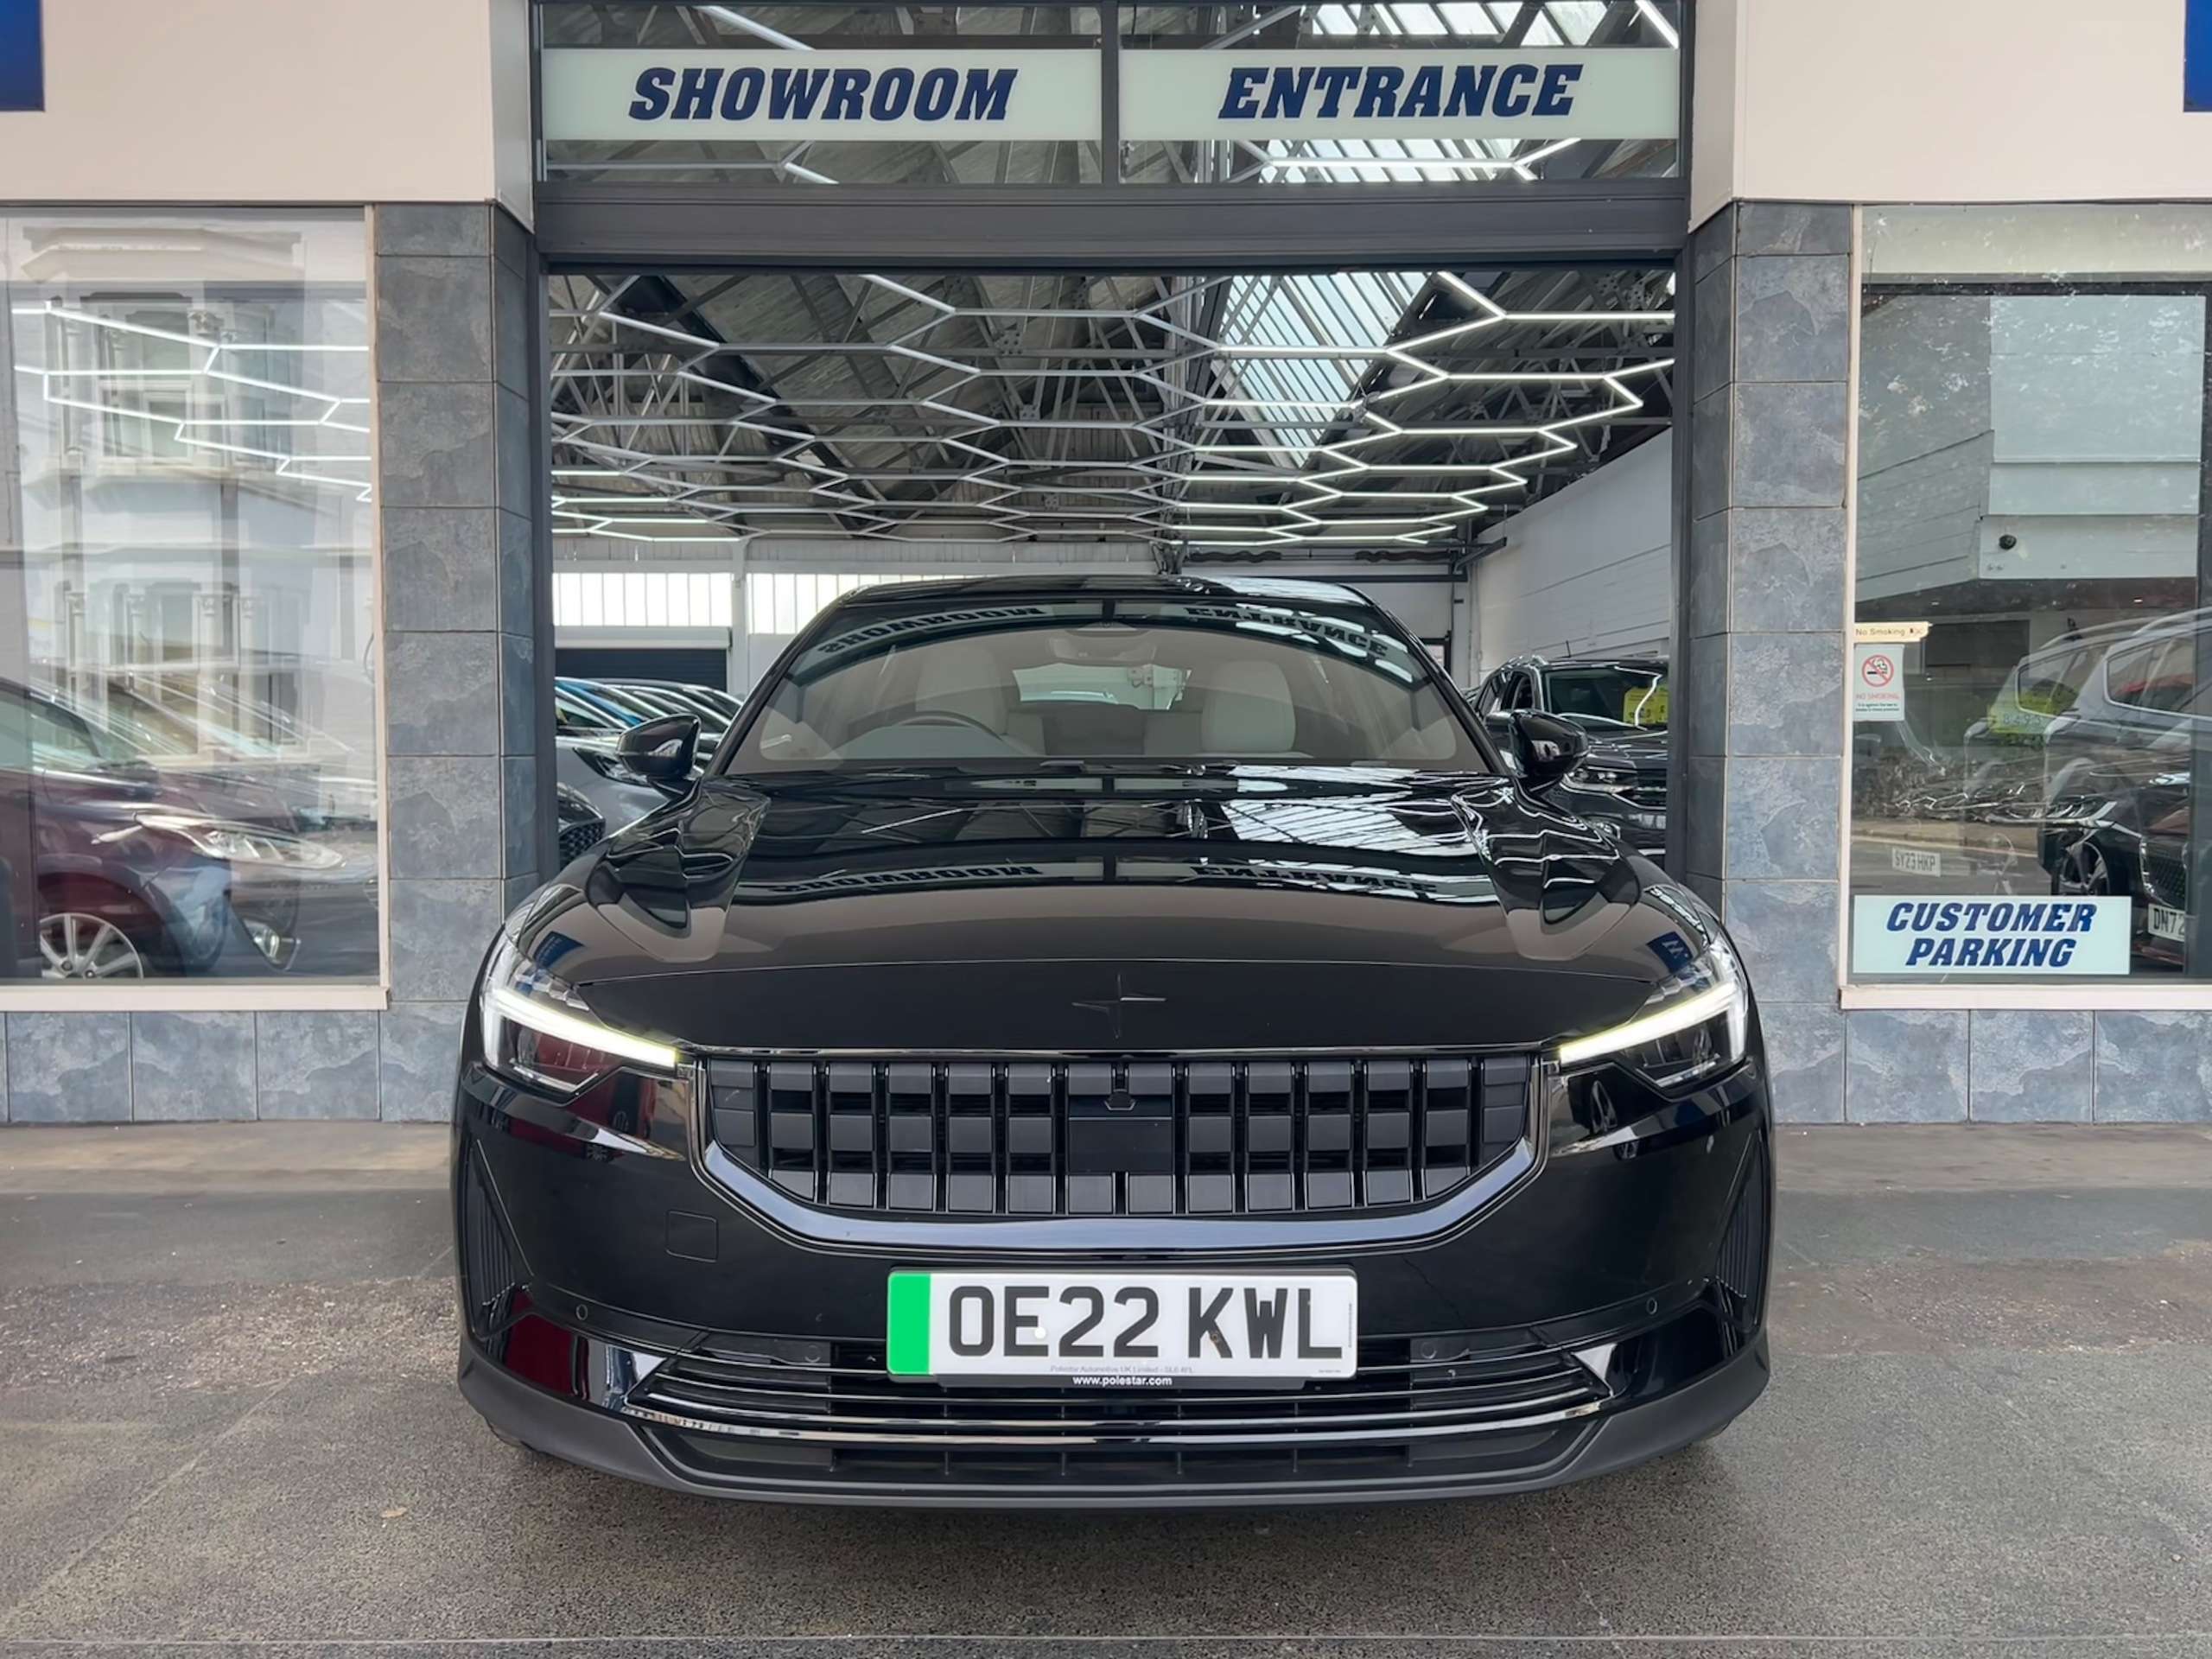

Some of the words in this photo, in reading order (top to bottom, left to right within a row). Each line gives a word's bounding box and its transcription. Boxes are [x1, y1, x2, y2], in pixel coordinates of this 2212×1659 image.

[628, 67, 1018, 121] SHOWROOM
[1217, 64, 1583, 118] ENTRANCE
[1870, 628, 1905, 637] Smoking
[1887, 903, 2097, 932] CUSTOMER
[1905, 938, 2077, 968] PARKING
[949, 1285, 1160, 1358] OE22
[1187, 1287, 1343, 1360] KWL
[1072, 1376, 1173, 1387] www.polestar.com
